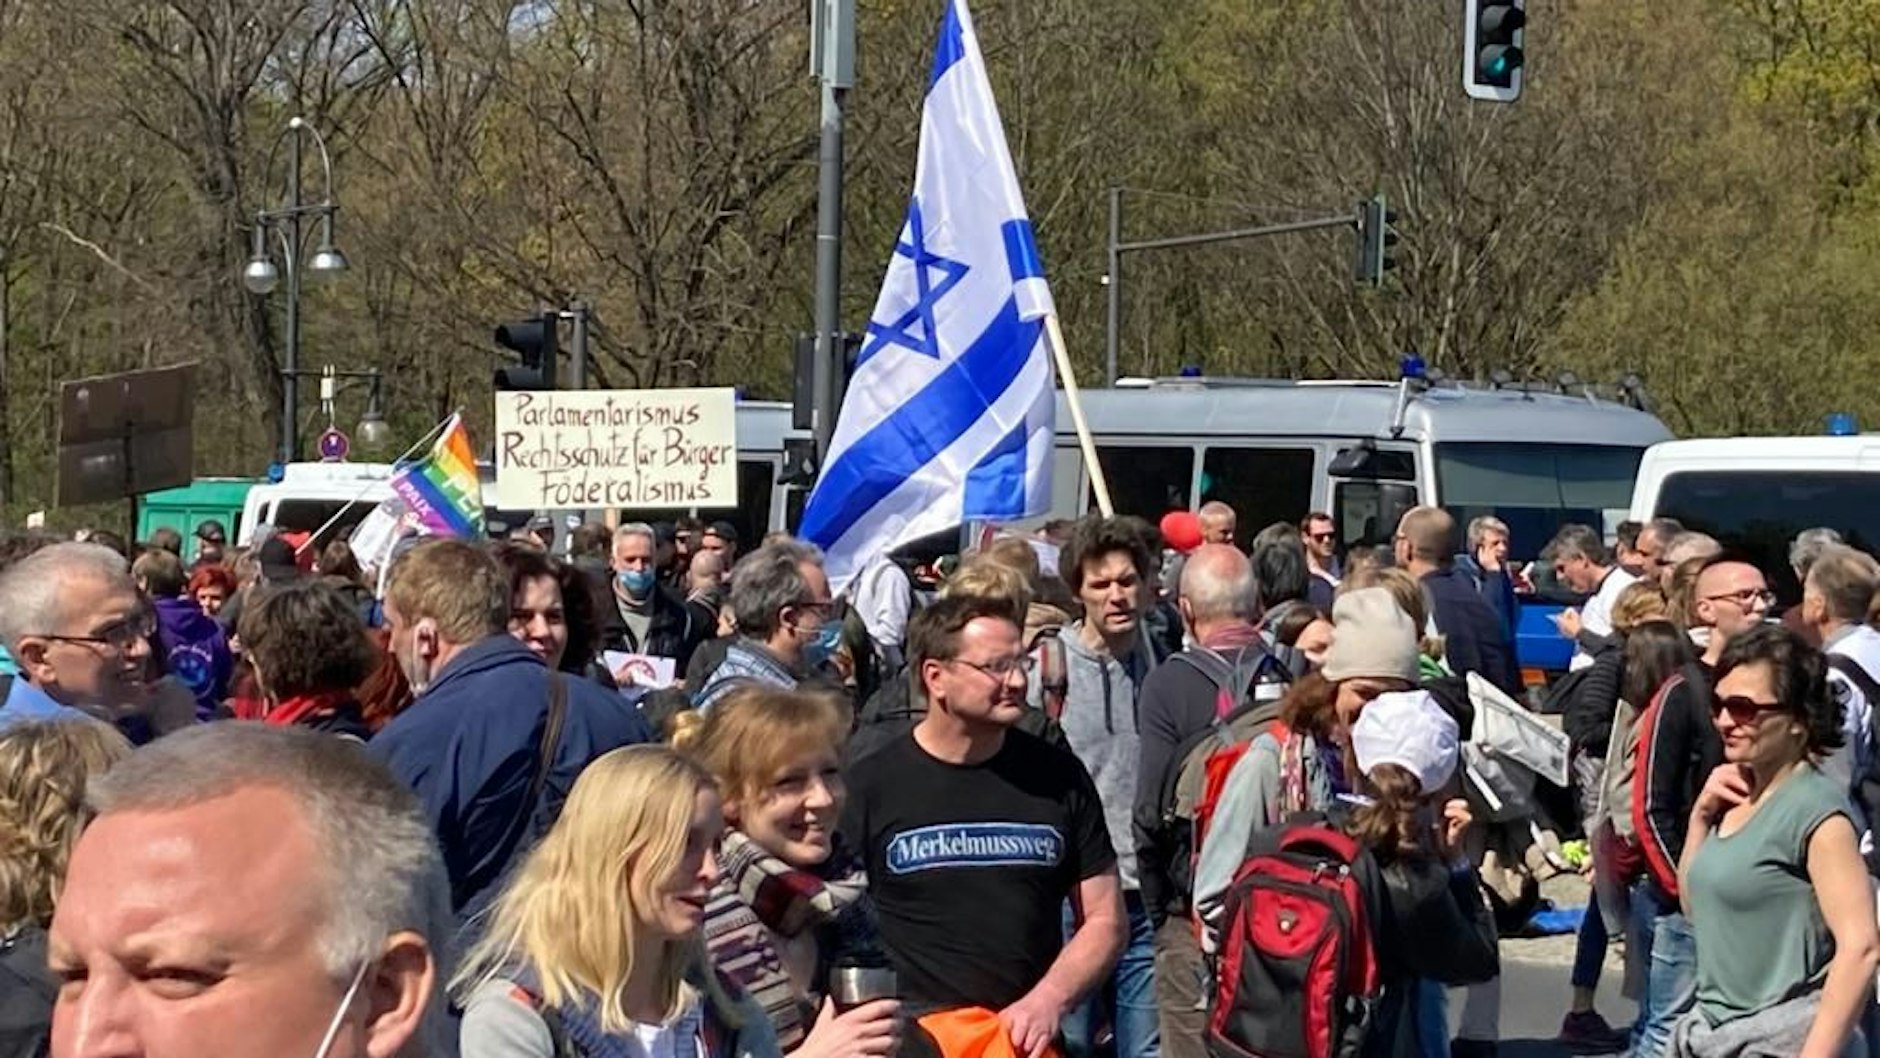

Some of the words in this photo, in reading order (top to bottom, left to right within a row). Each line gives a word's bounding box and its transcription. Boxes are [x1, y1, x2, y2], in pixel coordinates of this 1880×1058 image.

[512, 392, 700, 427] Parlamentarismus
[502, 429, 630, 469] Rechtsschutz
[632, 427, 657, 472] für
[663, 426, 733, 480] Bürger
[398, 481, 435, 517] PAIX
[539, 469, 712, 505] Föderalismus
[896, 830, 1056, 864] Merkelmussweg
